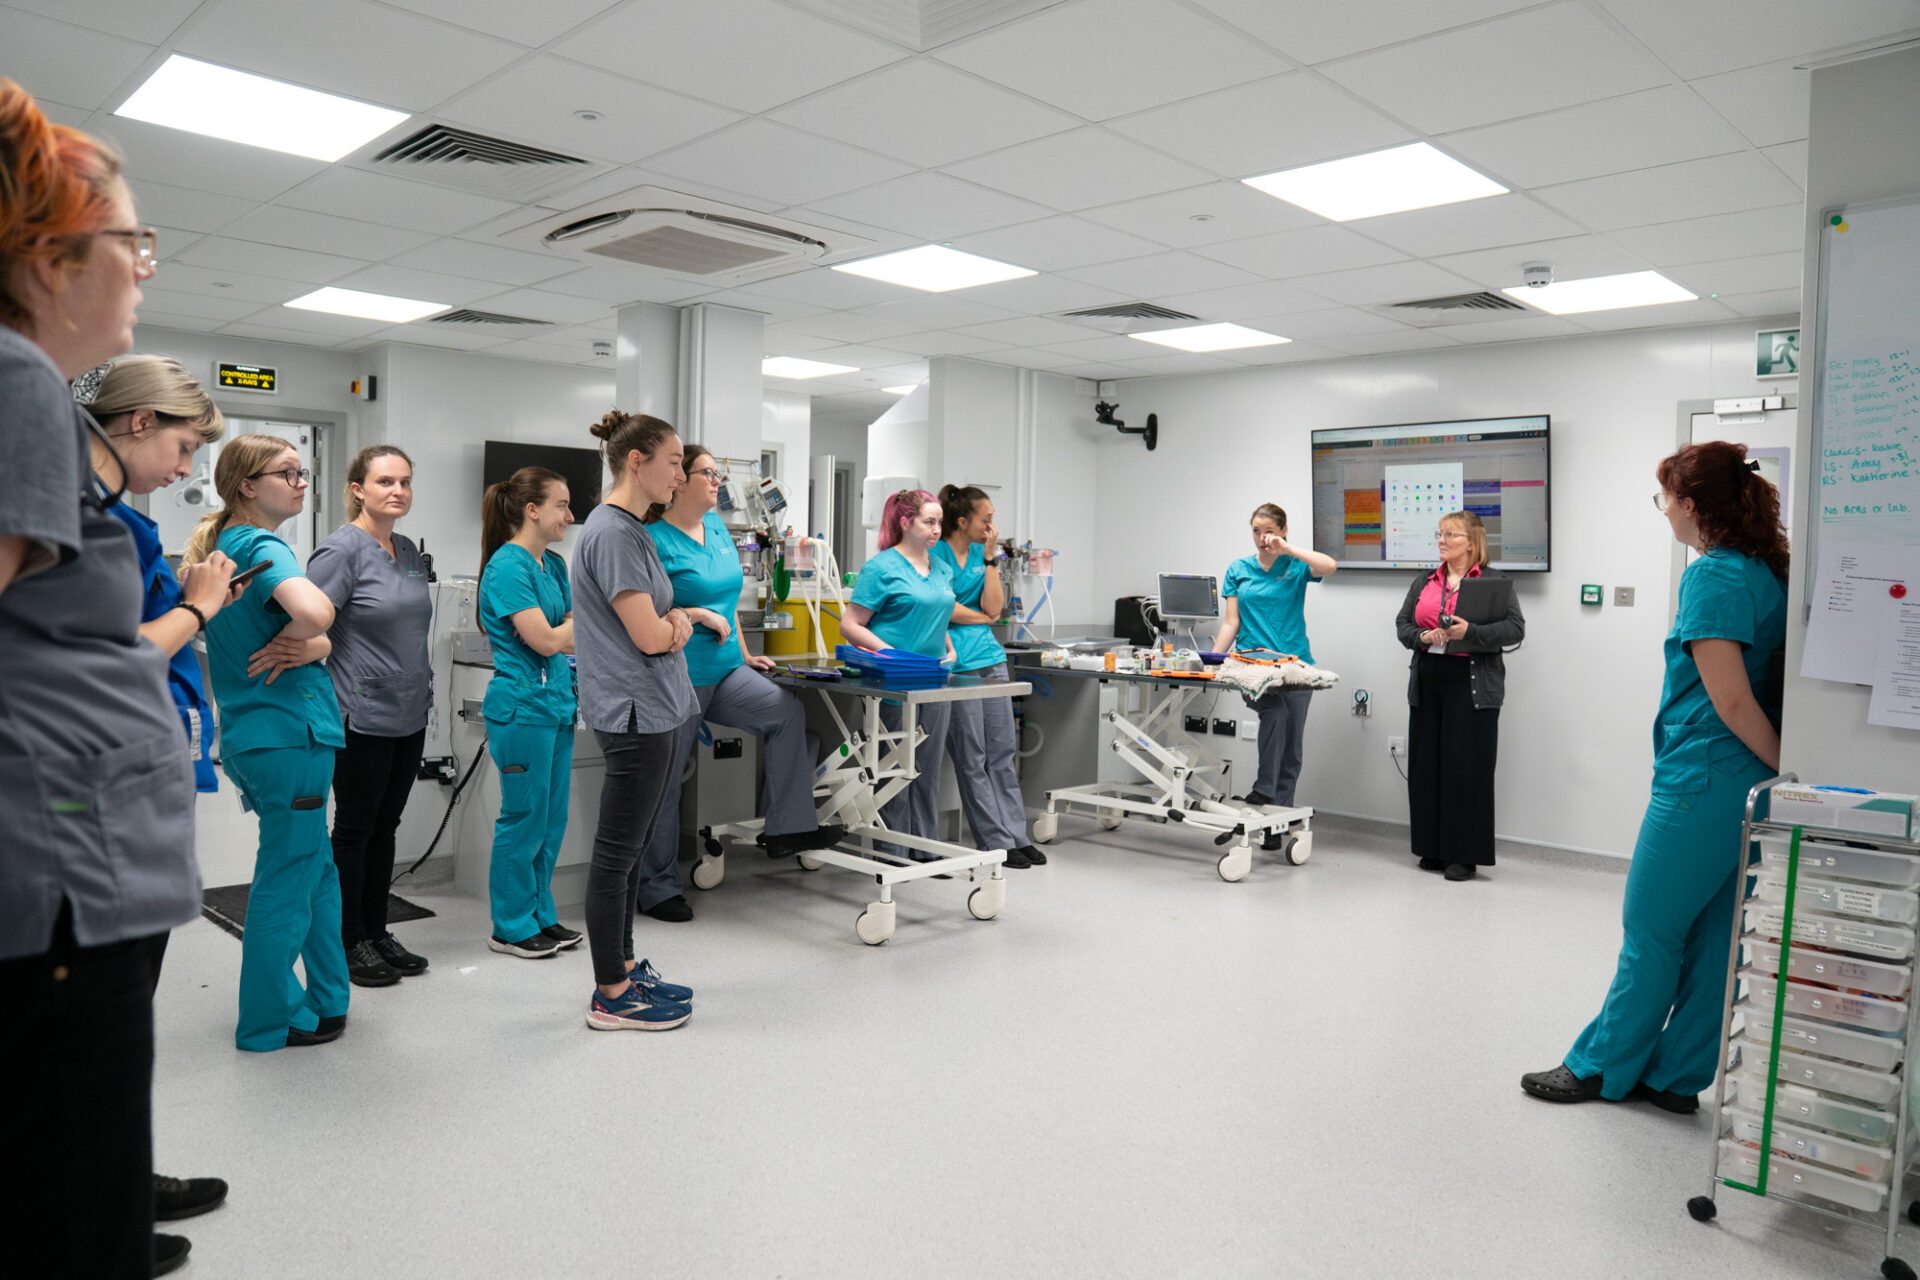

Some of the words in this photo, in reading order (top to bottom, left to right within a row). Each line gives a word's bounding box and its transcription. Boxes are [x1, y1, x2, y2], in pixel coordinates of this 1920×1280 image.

[221, 370, 258, 379] CONTROLLED
[259, 374, 274, 382] AREA
[237, 378, 258, 386] X-RAYS
[1824, 505, 1838, 515] No
[1871, 505, 1883, 513] or
[1773, 789, 1818, 800] NITREX
